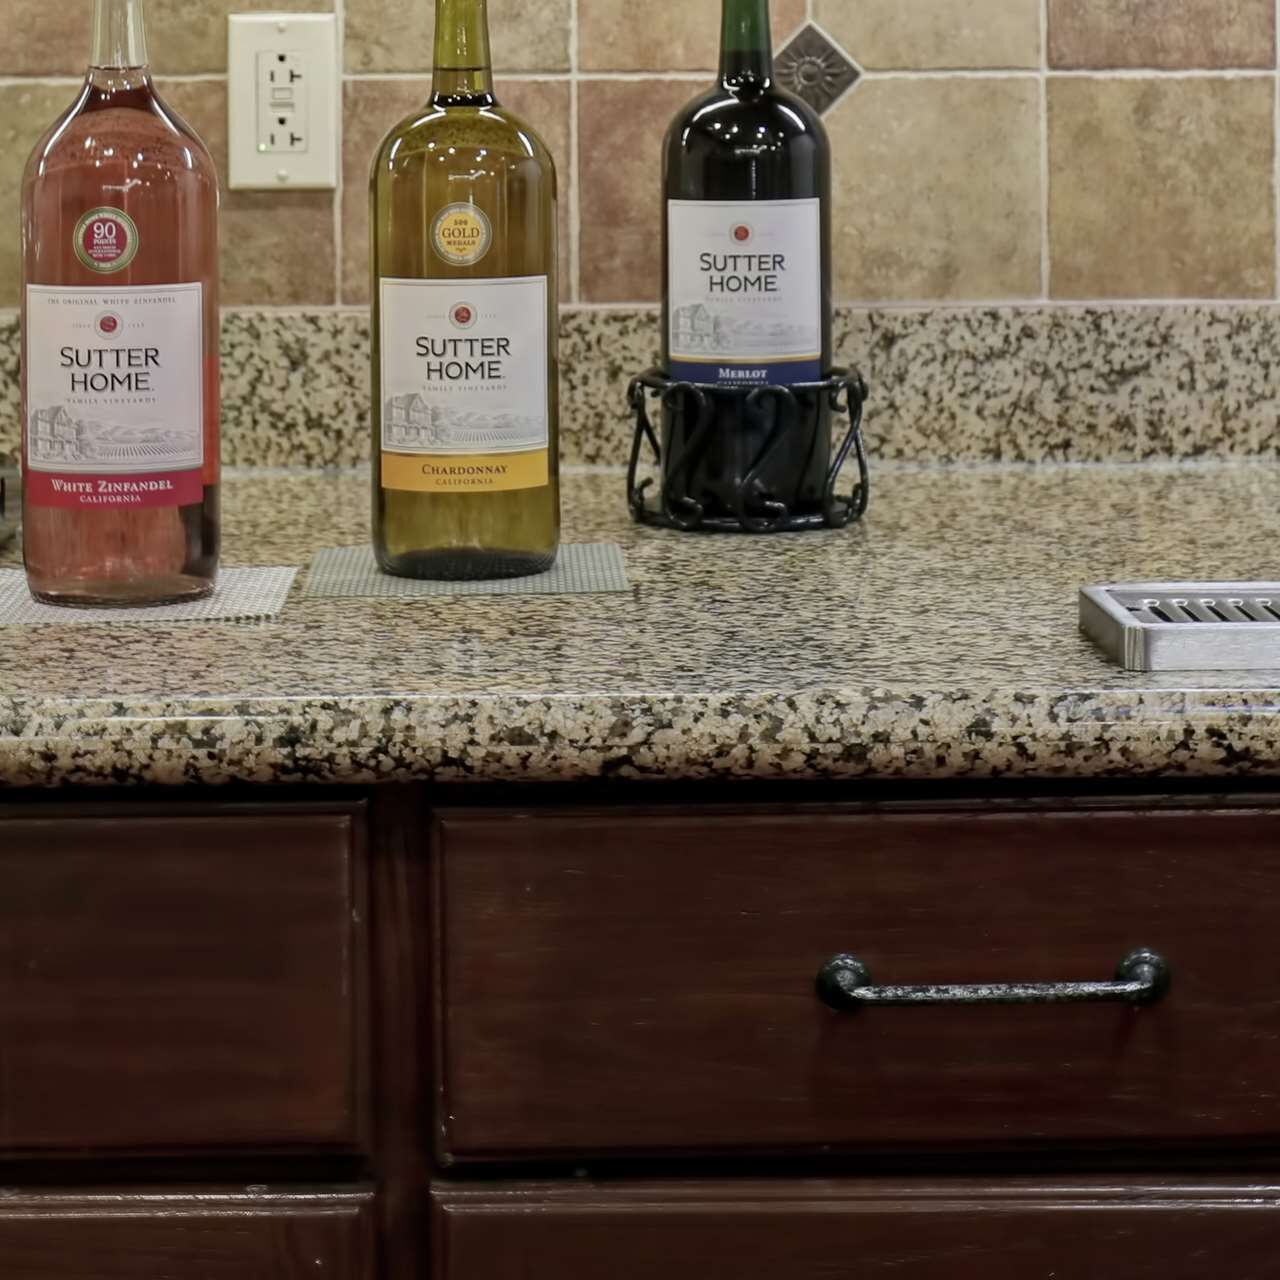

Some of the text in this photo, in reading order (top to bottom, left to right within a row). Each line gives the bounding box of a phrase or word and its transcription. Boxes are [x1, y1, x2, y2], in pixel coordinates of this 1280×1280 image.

[93, 222, 116, 239] 90
[442, 227, 480, 238] GOLD
[699, 252, 786, 272] SUTTER
[709, 274, 778, 293] HOME
[416, 336, 511, 357] SUTTER
[60, 346, 160, 368] SUTTER
[427, 360, 502, 380] HOME
[71, 371, 151, 392] HOME
[422, 464, 508, 476] CHARDONNAY
[51, 479, 173, 493] WHITE ZINFANDEL
[435, 478, 494, 486] CALIFORNIA
[79, 495, 141, 503] CALIFORNIA
